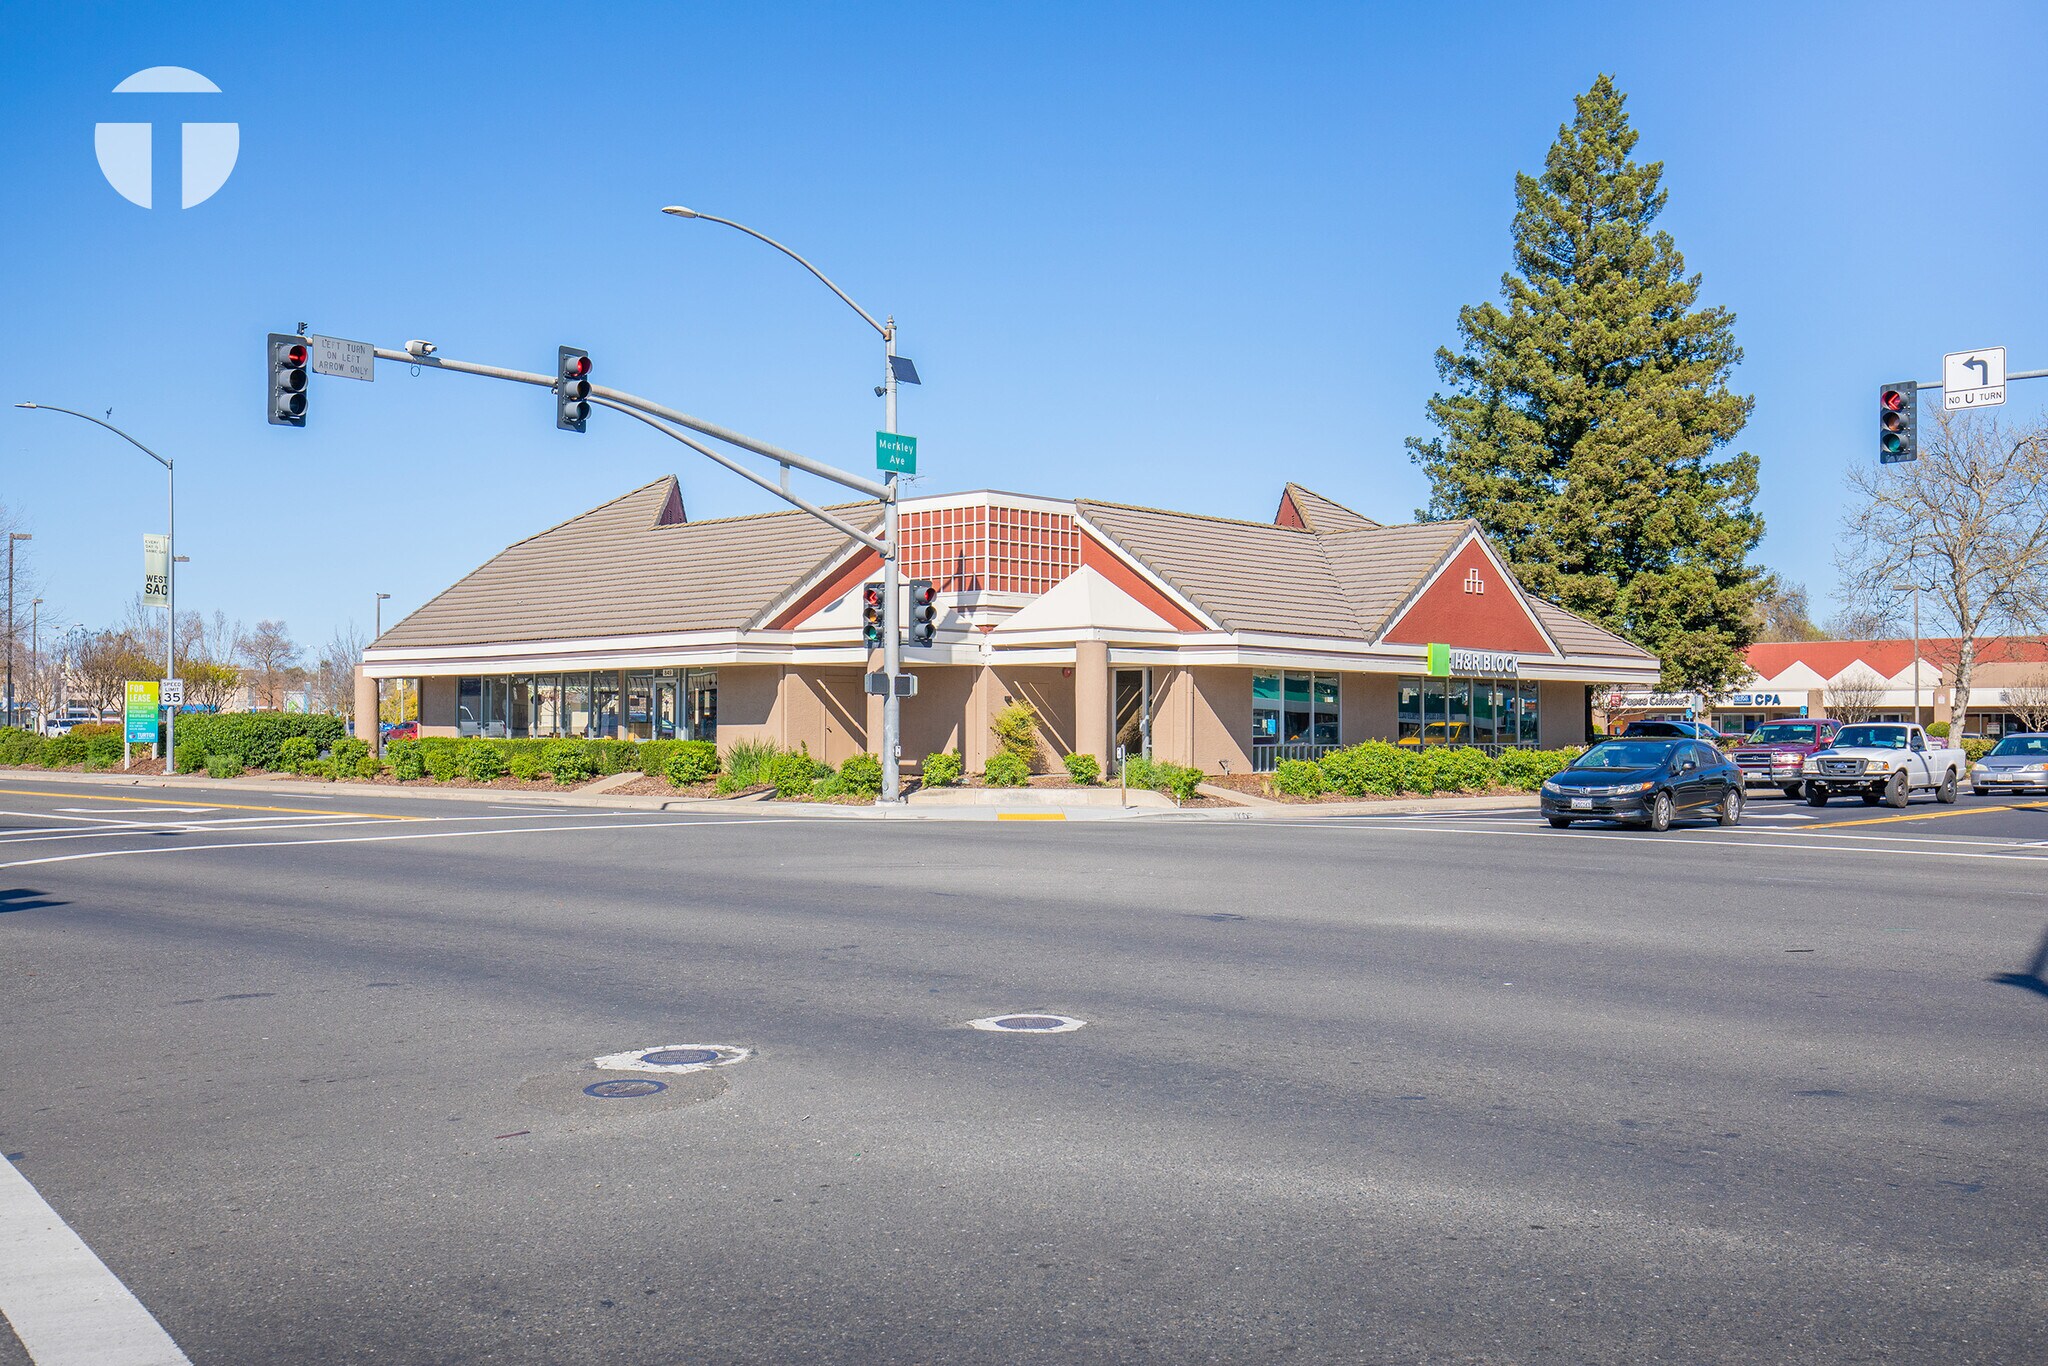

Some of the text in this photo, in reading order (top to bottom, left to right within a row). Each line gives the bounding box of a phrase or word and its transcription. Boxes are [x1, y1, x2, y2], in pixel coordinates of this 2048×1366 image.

[321, 340, 366, 354] LEFT TURN
[327, 351, 360, 364] ON LEFT
[319, 361, 369, 375] ARROW ONLY
[1949, 391, 2002, 404] NO U TURN
[879, 439, 914, 455] Merkley
[889, 455, 905, 466] Ave
[146, 574, 168, 584] WEST
[145, 583, 168, 596] SAC
[1455, 652, 1520, 673] H&R BLOCK
[130, 684, 144, 692] FOR
[130, 694, 151, 702] LEASE
[164, 692, 181, 702] 35
[1755, 693, 1781, 705] CPA
